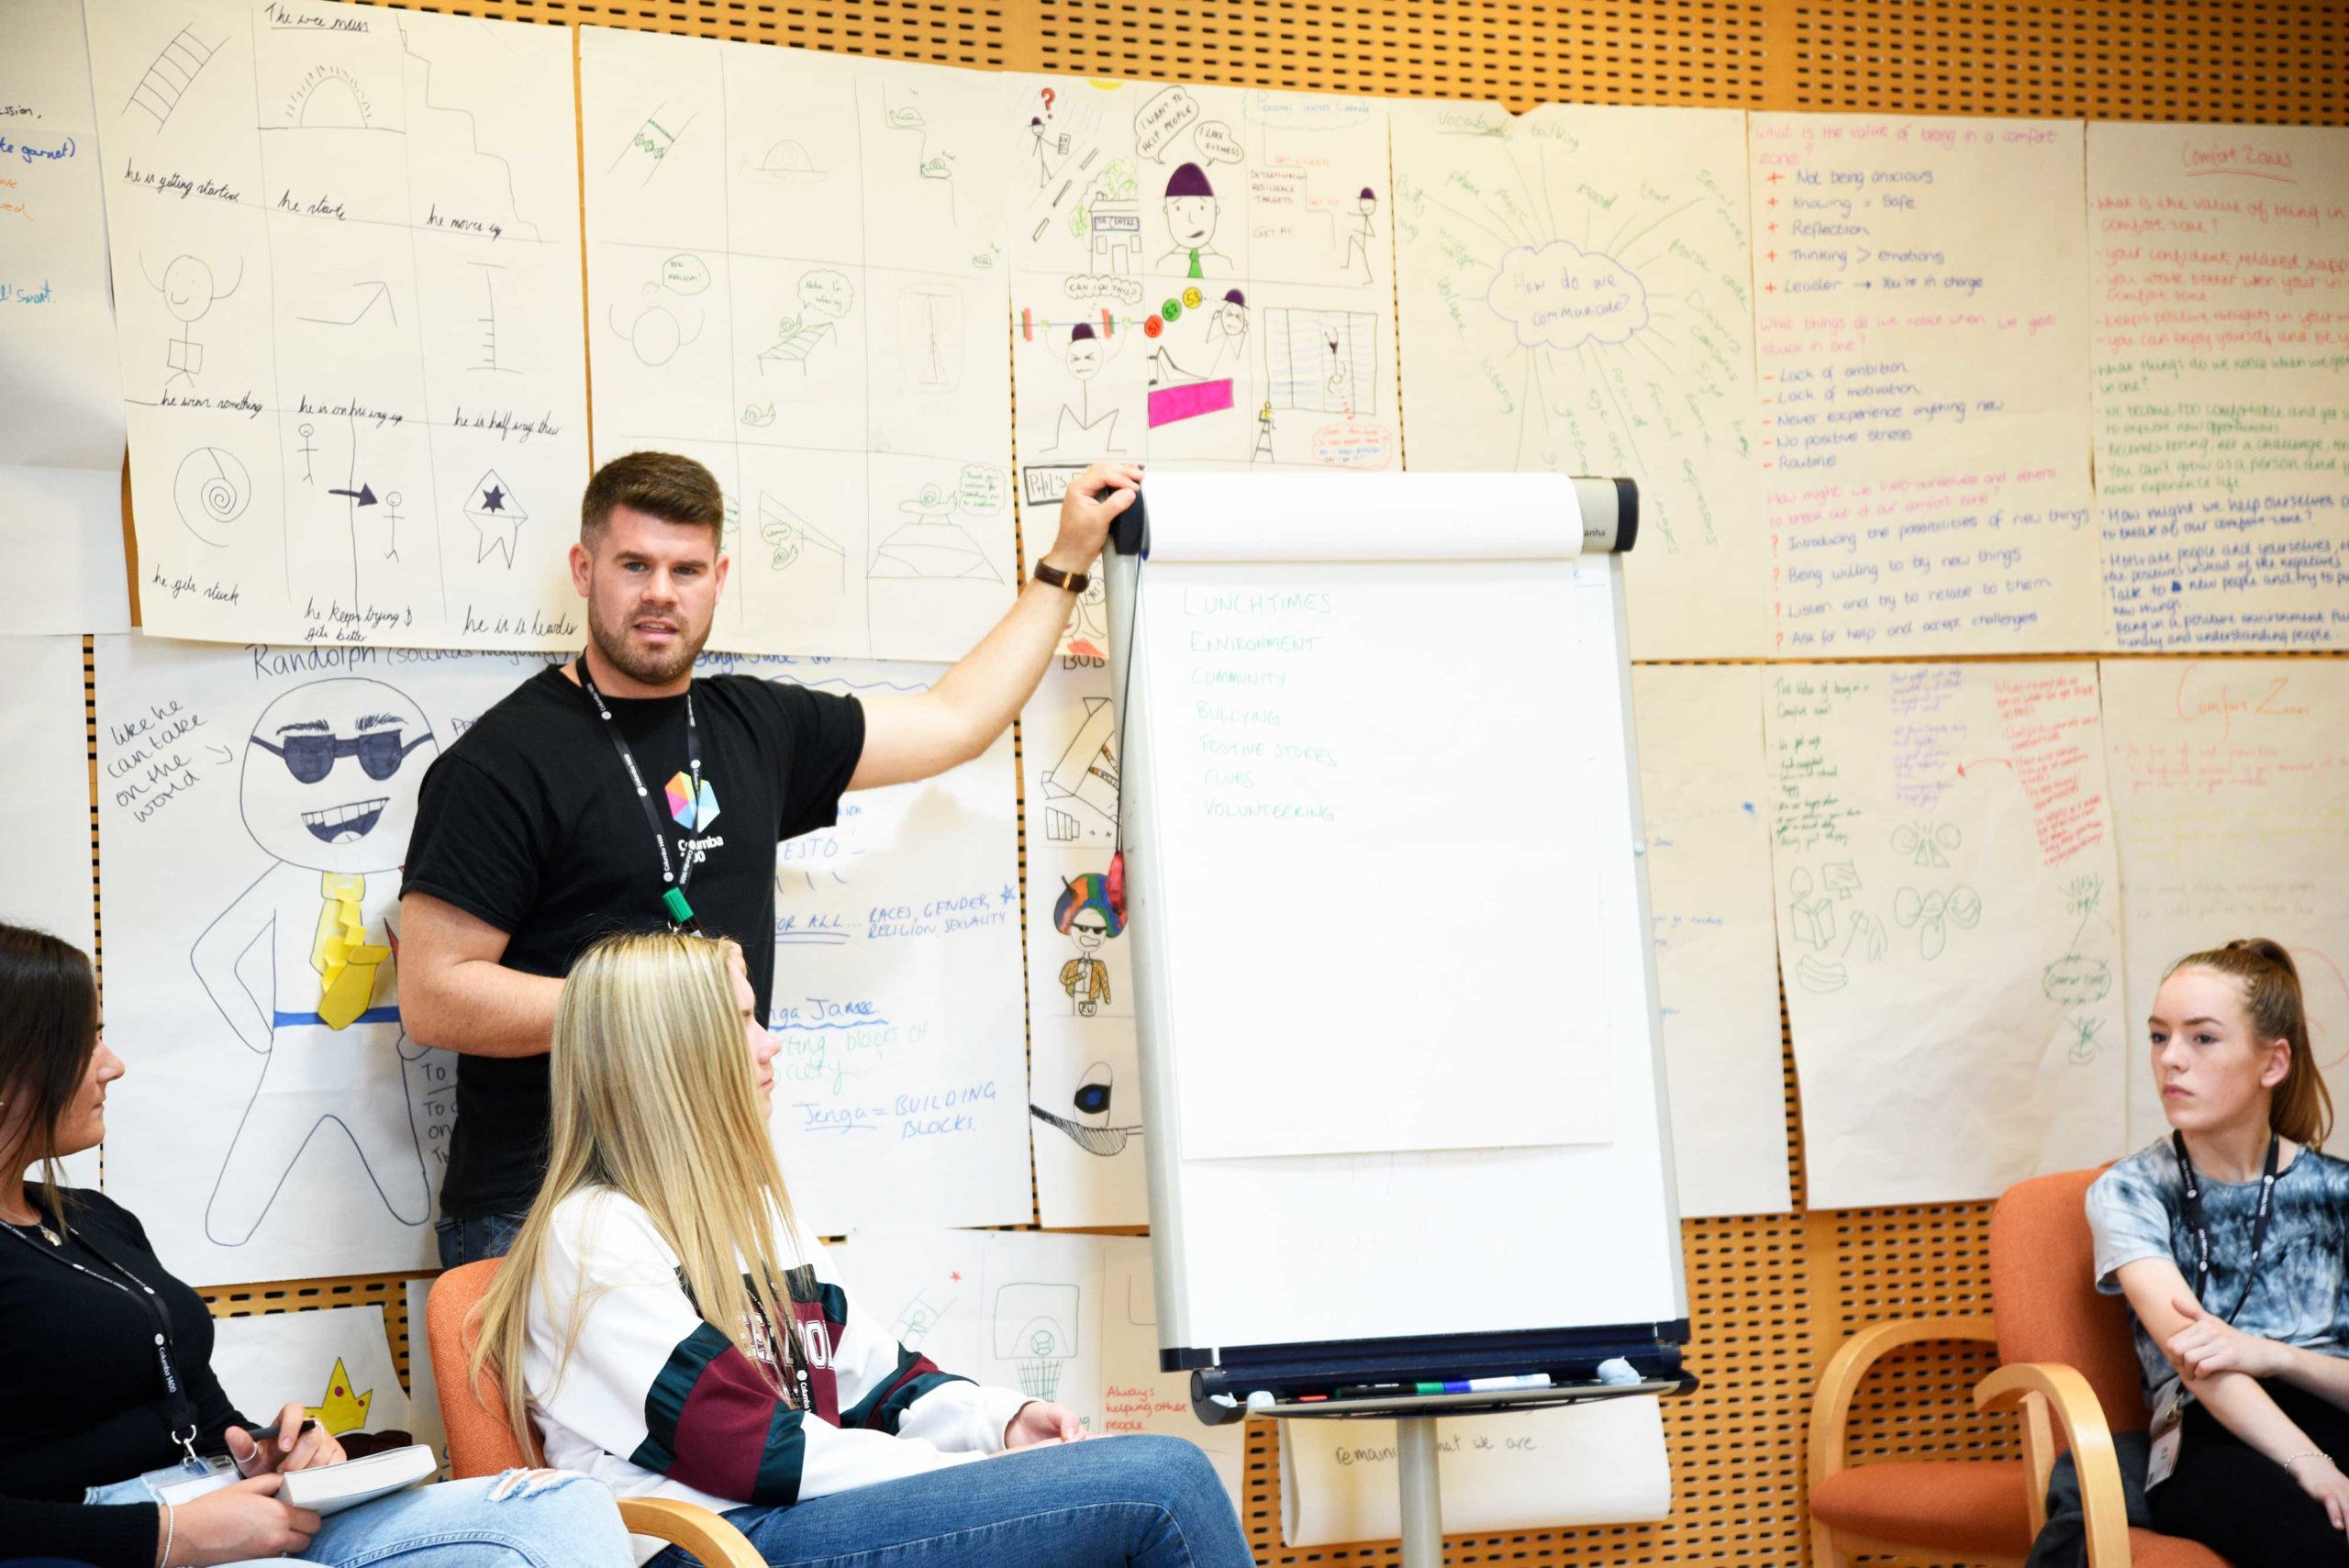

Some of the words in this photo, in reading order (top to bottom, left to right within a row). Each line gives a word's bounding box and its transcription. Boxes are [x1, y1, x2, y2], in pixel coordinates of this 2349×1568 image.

[264, 4, 296, 25] The
[296, 14, 325, 28] wee
[331, 18, 369, 32] man
[1147, 102, 1170, 125] WANT
[1173, 94, 1183, 104] TO
[1142, 130, 1160, 152] HELP
[1164, 105, 1192, 130] PEOPLE
[1206, 128, 1223, 139] LIKE
[1207, 142, 1240, 157] FITNESS
[2182, 144, 2236, 167] Comfort
[2245, 147, 2293, 167] Zones
[125, 158, 140, 183] he
[158, 173, 194, 199] getting
[198, 181, 239, 203] started
[1797, 171, 1822, 184] Not
[1831, 170, 1865, 189] being
[278, 190, 299, 212] he
[1254, 195, 1293, 205] TARGETS
[1793, 196, 1853, 218] Knowing
[427, 204, 447, 226] he
[1792, 221, 1870, 237] Reflection
[1790, 249, 1849, 271] Thinking
[1878, 250, 1945, 265] emotions
[1513, 272, 1546, 293] How
[1561, 266, 1578, 290] do
[1784, 279, 1844, 295] Leader
[1943, 276, 1984, 295] charge
[1069, 284, 1089, 292] CAN
[1112, 285, 1138, 300] THIS?
[1780, 367, 1812, 383] Lack
[1845, 361, 1909, 378] ambition
[161, 389, 176, 406] he
[217, 390, 263, 419] something
[298, 395, 313, 414] he
[1778, 389, 1813, 404] Lack
[1847, 384, 1921, 398] motivation
[453, 406, 468, 426] he
[488, 409, 513, 441] half
[1777, 414, 1818, 427] Never
[1827, 406, 1902, 426] experience
[1776, 435, 1798, 449] No
[1805, 430, 1858, 451] positive
[1868, 427, 1912, 441] stress
[1779, 454, 1836, 470] Routine
[1788, 530, 1857, 552] Introducing
[2049, 507, 2090, 530] things
[1788, 567, 1822, 587] Being
[1978, 550, 2021, 569] things
[152, 563, 166, 589] he
[203, 582, 239, 605] stuck
[304, 596, 321, 619] he
[1184, 587, 1332, 617] LUNCHTIMES
[462, 604, 489, 636] he
[531, 609, 579, 637] leader
[1792, 631, 1818, 645] Ask
[1846, 626, 1876, 643] help
[1973, 611, 2038, 633] challenges
[336, 627, 368, 642] better
[1190, 630, 1324, 652] ENVIRONMENT
[244, 645, 377, 681] Randolph
[1191, 668, 1286, 688] COMMUNITY
[110, 717, 154, 746] like
[154, 699, 184, 726] he
[1196, 700, 1281, 726] BULLYING
[107, 749, 154, 779] can
[145, 713, 209, 754] take
[117, 782, 152, 809] on
[146, 755, 192, 790] the
[1205, 770, 1255, 788] CLUBS
[134, 770, 200, 823] world
[1205, 799, 1335, 822] VOLUNTEERING
[924, 895, 990, 919] GENDER,
[943, 911, 1007, 933] SEXUALITY
[792, 1102, 868, 1135] Jenga
[894, 1081, 997, 1117] BUILDING
[159, 1347, 171, 1376] Columba
[166, 1375, 176, 1393] 1400
[1107, 1385, 1156, 1403] Always
[1106, 1402, 1153, 1422] helping
[1155, 1401, 1188, 1413] other
[1106, 1418, 1144, 1434] people
[1474, 1434, 1495, 1451] we
[1507, 1435, 1538, 1451] are
